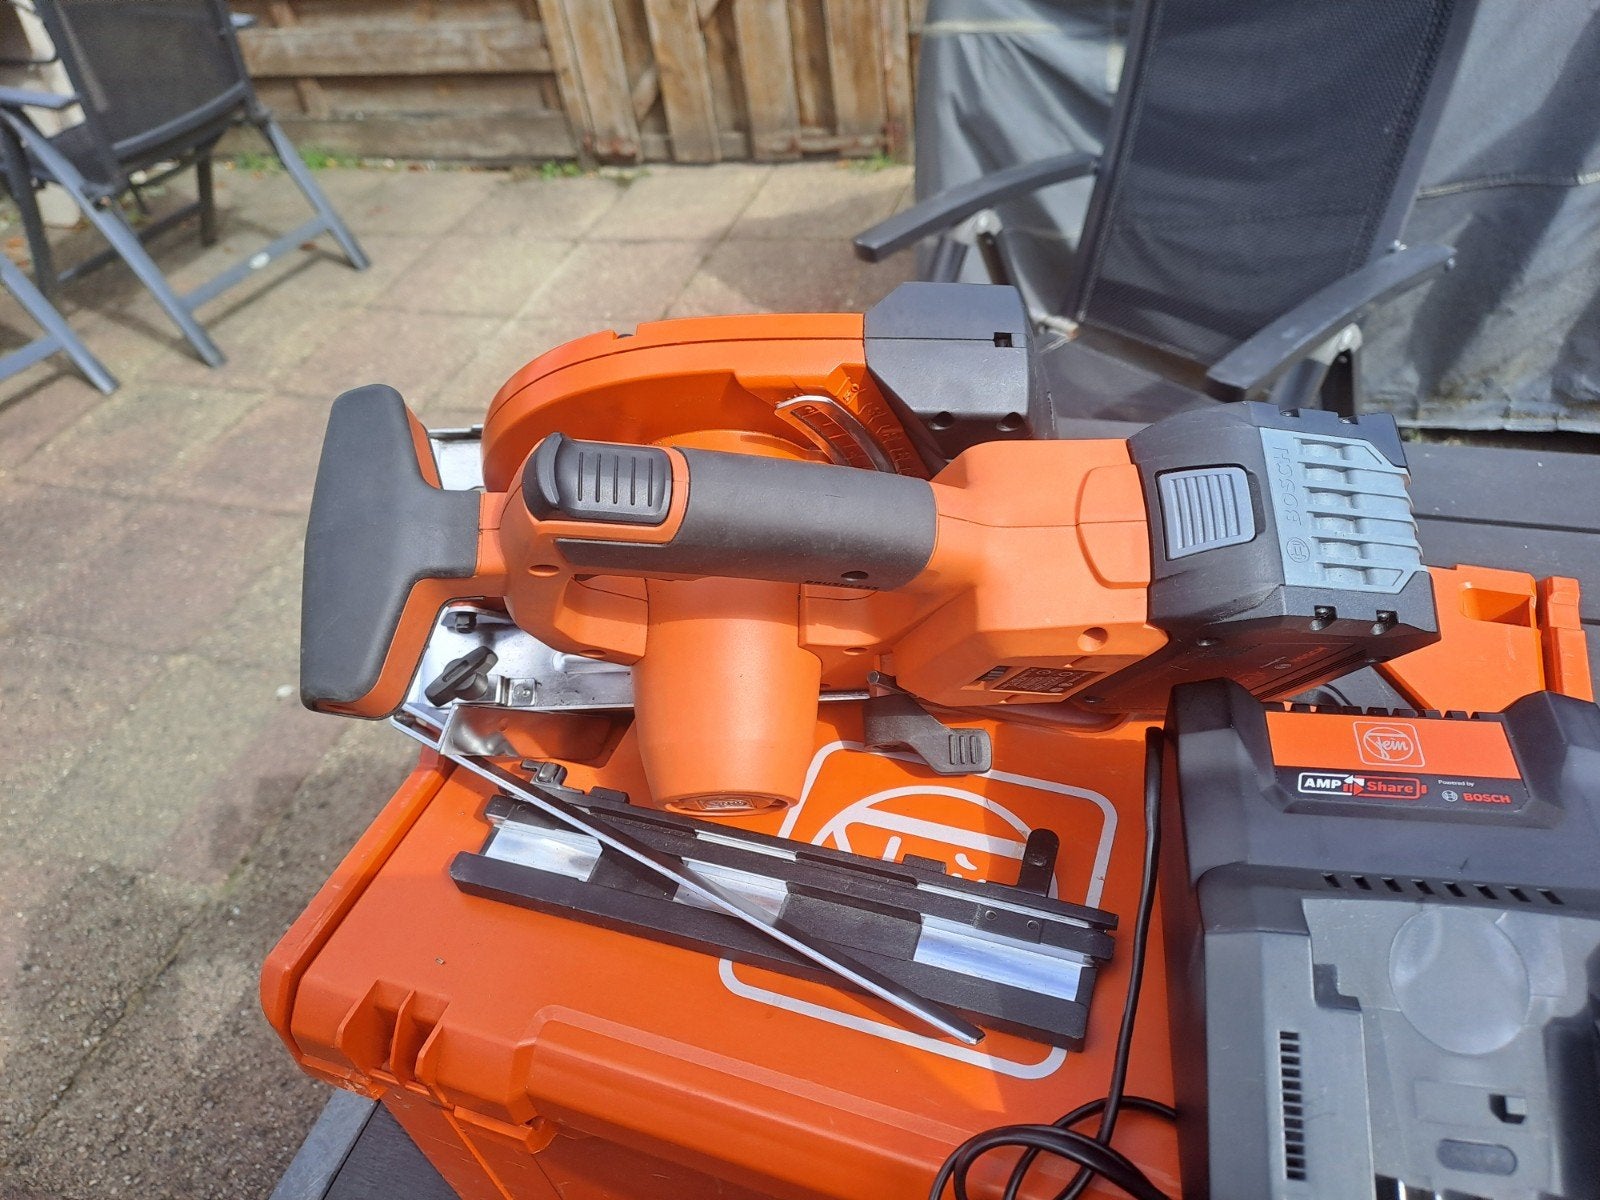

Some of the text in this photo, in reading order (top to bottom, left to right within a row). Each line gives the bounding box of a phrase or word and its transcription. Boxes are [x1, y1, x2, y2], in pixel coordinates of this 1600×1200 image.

[1272, 446, 1302, 526] BOSCH
[1304, 777, 1414, 794] AMP Share
[1438, 779, 1466, 787] Powered
[1463, 792, 1512, 804] BOSCH
